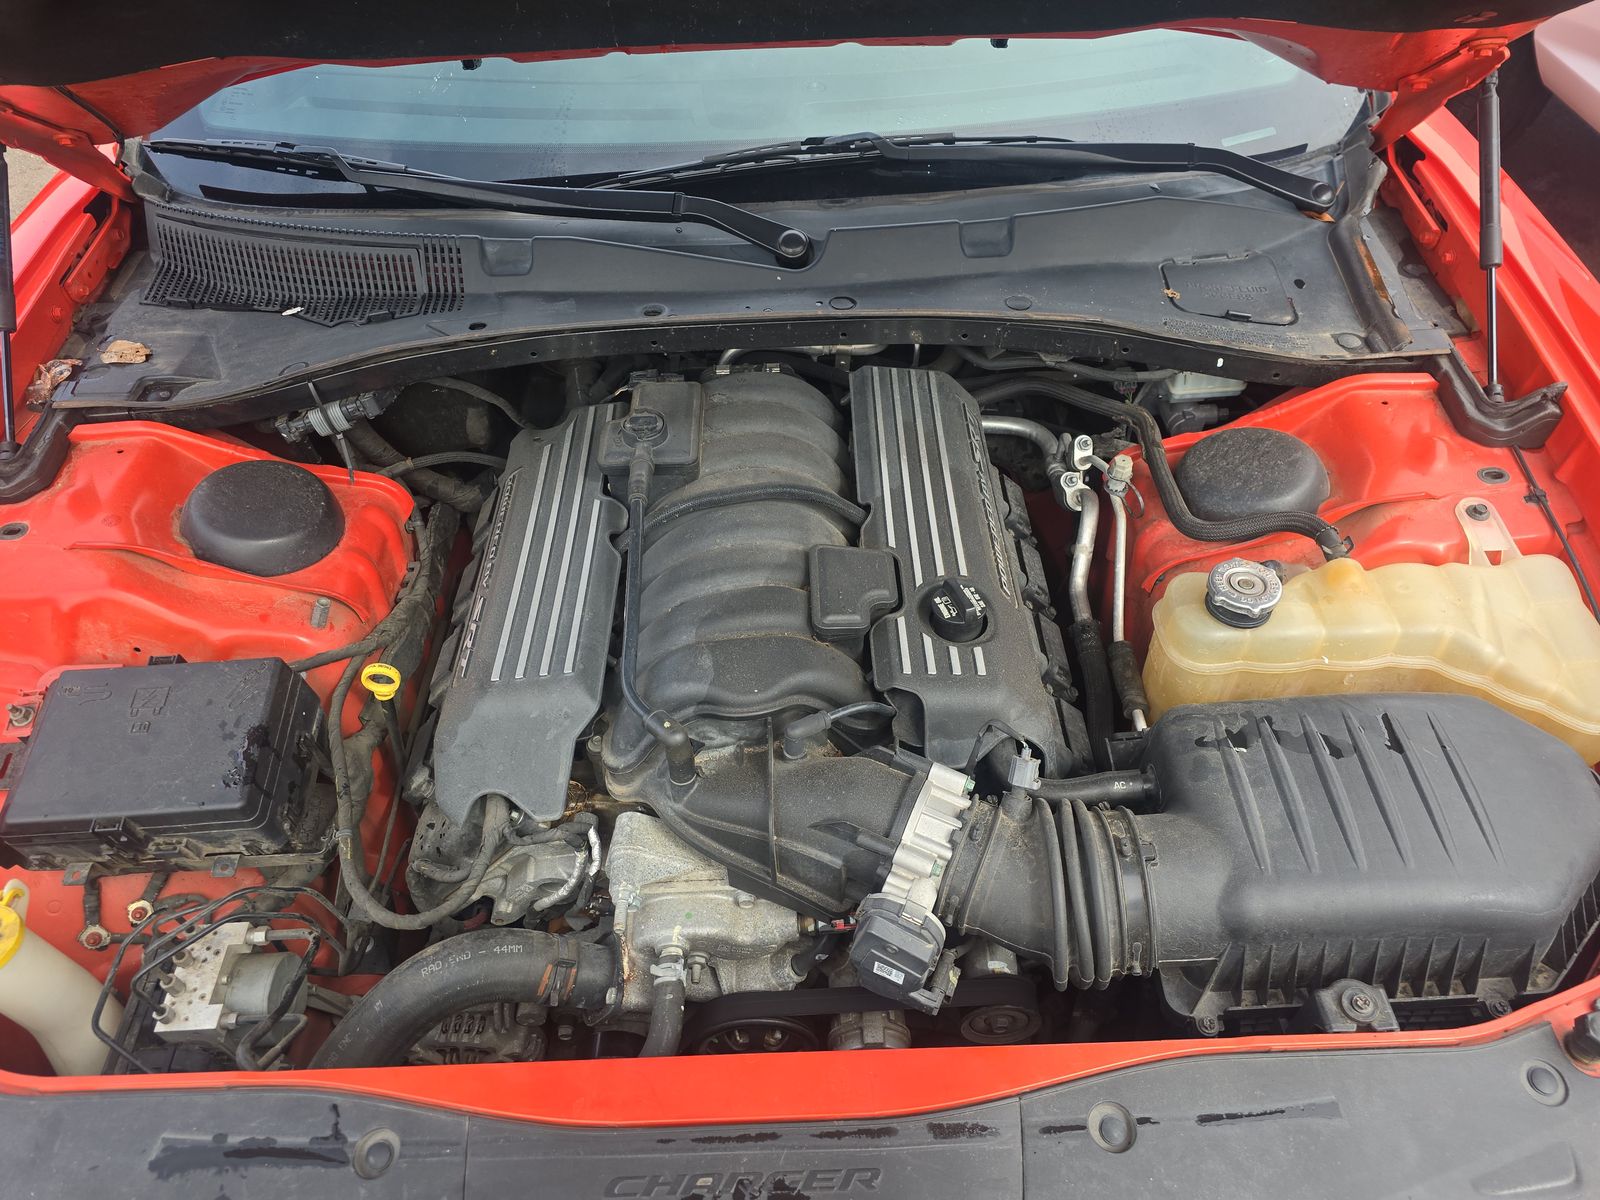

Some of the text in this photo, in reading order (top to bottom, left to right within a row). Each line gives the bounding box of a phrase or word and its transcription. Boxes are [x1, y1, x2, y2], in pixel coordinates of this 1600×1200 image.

[461, 596, 484, 678] SRT
[1114, 781, 1127, 790] AC
[421, 960, 443, 977] RAD
[493, 944, 523, 954] 44MM
[603, 1167, 882, 1198] CHARGER
